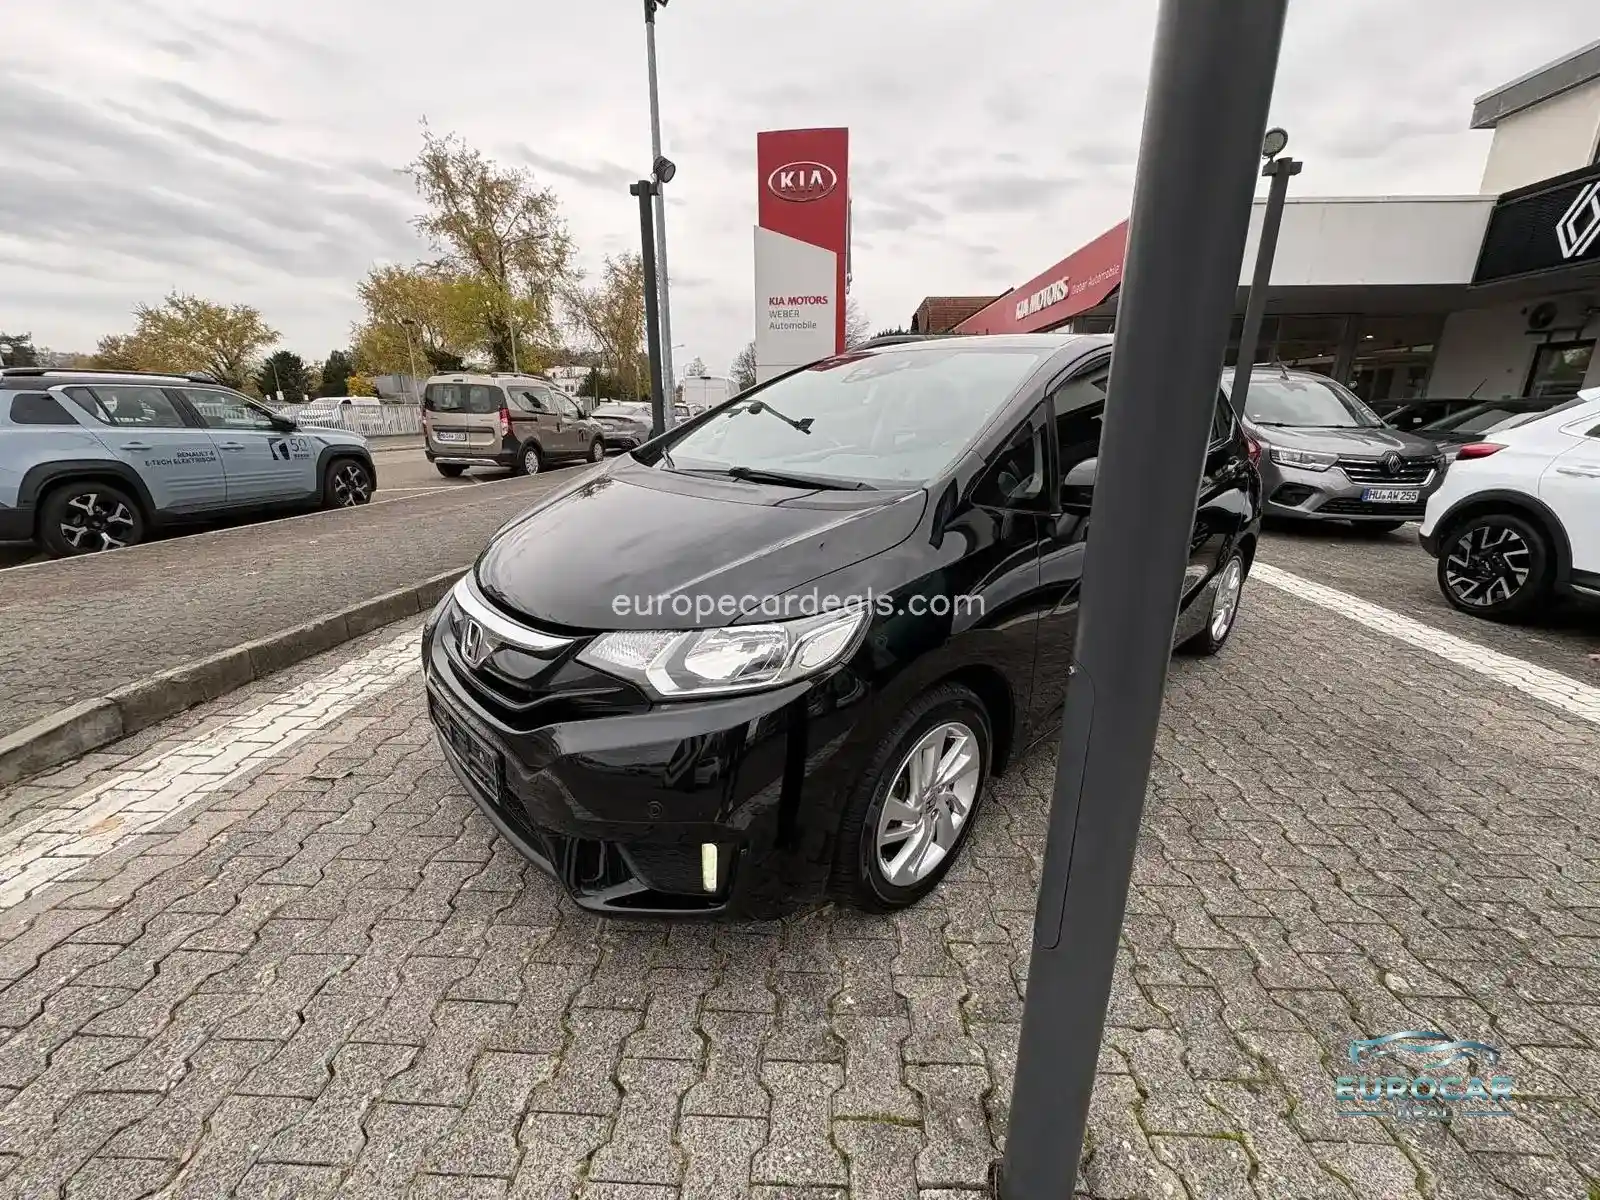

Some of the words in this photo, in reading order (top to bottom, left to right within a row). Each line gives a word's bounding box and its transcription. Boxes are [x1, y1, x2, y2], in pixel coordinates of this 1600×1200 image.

[780, 169, 825, 192] KIA
[769, 296, 785, 305] KIA
[788, 295, 828, 305] MOTORS
[1015, 297, 1029, 321] KIA
[1029, 276, 1070, 313] MOTORS
[769, 309, 799, 318] WEBER
[769, 320, 816, 330] Automobile
[1369, 490, 1382, 500] HU
[1387, 490, 1399, 500] AW
[1400, 491, 1417, 501] 255
